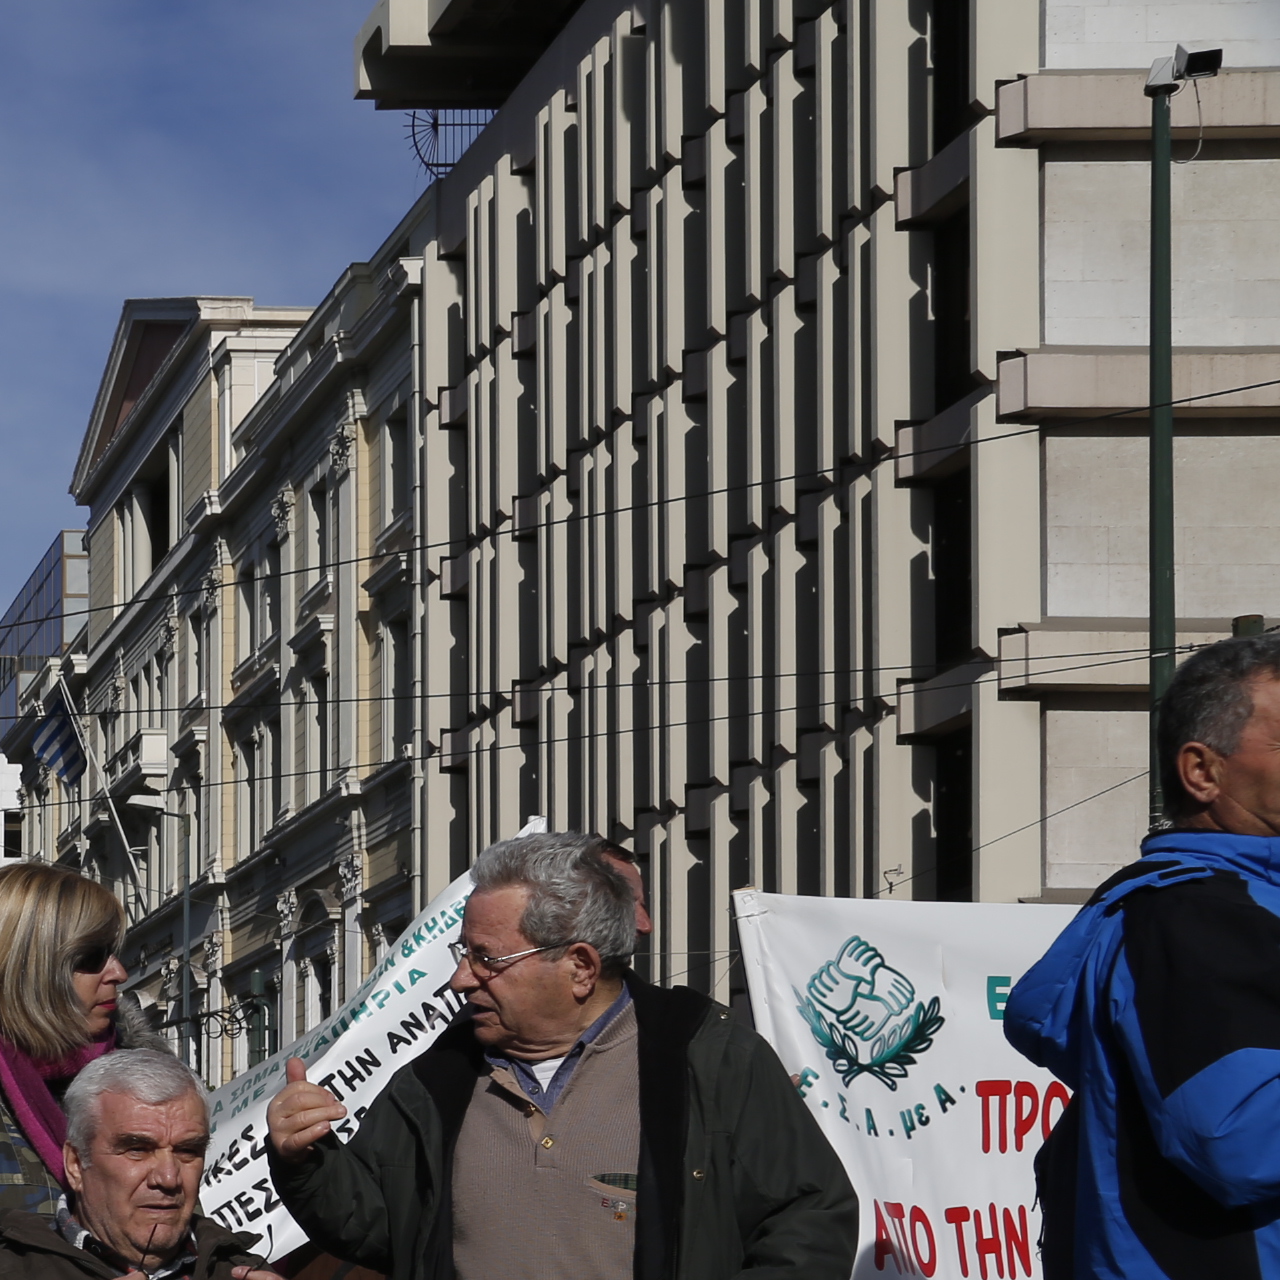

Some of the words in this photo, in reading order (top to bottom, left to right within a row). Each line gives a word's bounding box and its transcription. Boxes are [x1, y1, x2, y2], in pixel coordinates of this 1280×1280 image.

[386, 980, 464, 1054] ΑΝΑΠ
[873, 1199, 937, 1278] ΑΠΟ
[945, 1202, 1032, 1280] ΤΗΝ
